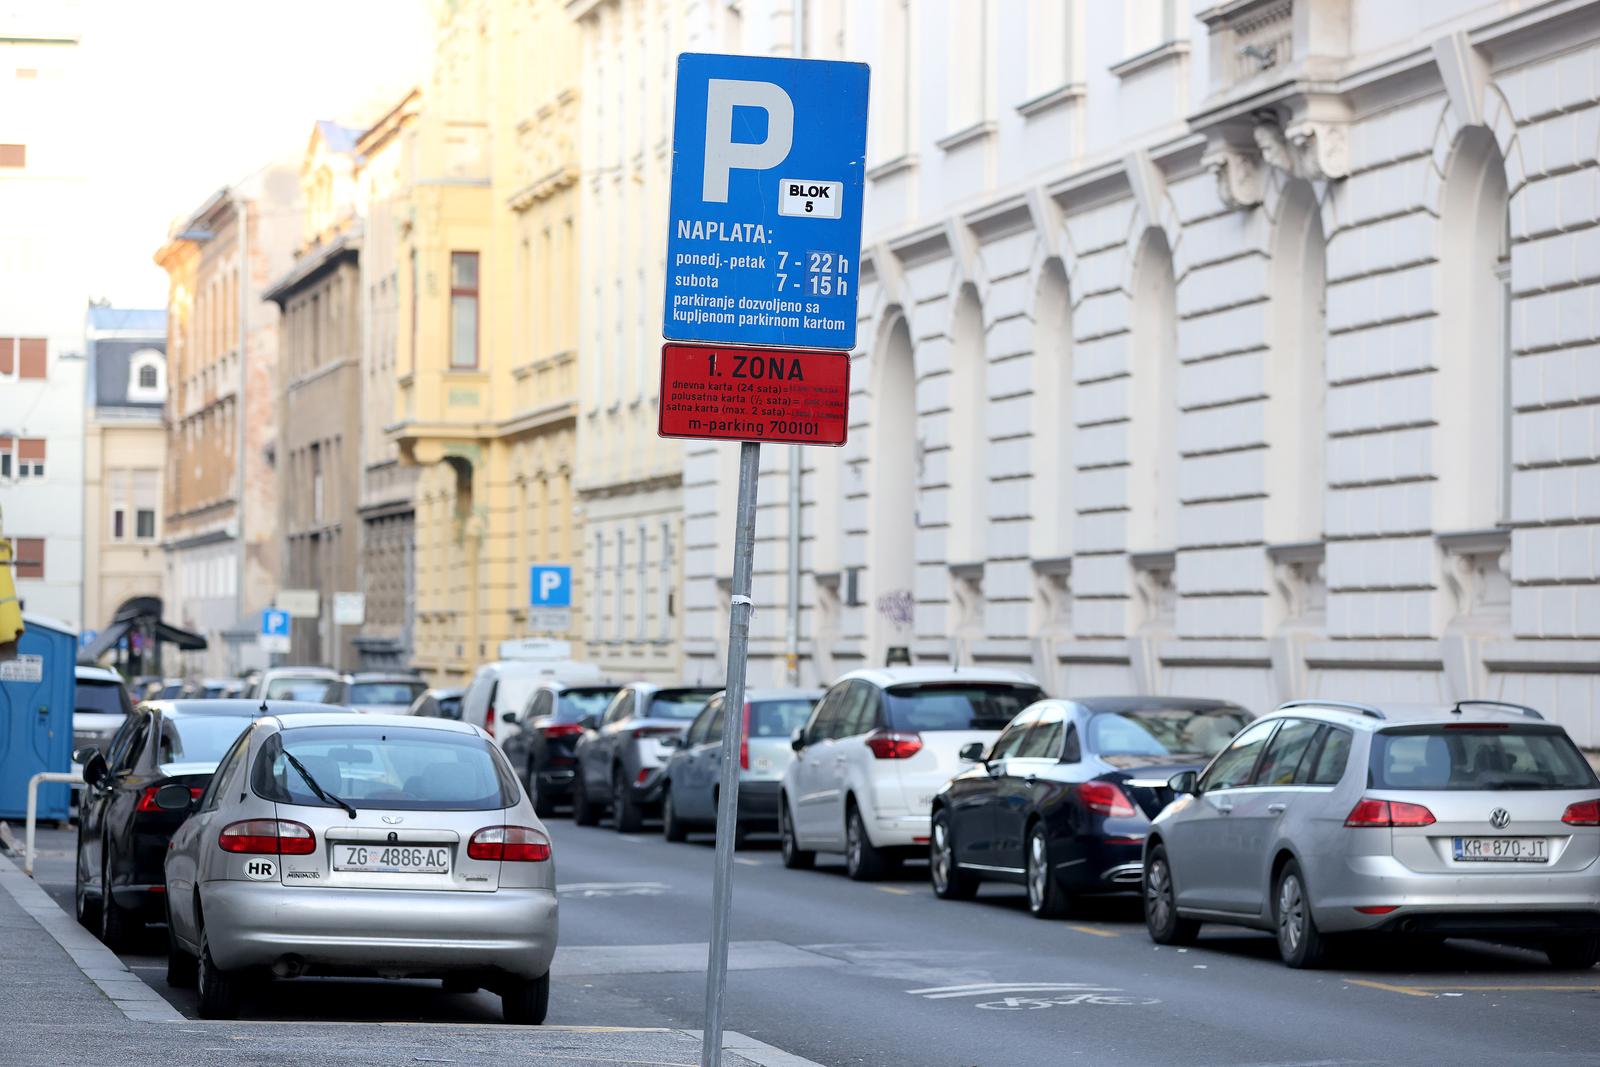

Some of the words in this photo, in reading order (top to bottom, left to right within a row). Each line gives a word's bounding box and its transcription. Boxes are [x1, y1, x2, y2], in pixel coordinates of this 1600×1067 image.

[702, 78, 794, 203] P
[789, 185, 830, 198] BLOK
[804, 201, 813, 212] 5
[677, 219, 773, 245] NAPLATA:
[777, 251, 789, 270] 7
[810, 253, 833, 273] 22
[838, 254, 849, 274] h
[675, 274, 719, 288] subota
[776, 273, 788, 292] 7
[810, 275, 832, 295] 15
[837, 276, 848, 296] h
[673, 294, 735, 310] parkiranje
[738, 296, 802, 314] dozvoljeno
[805, 302, 820, 314] sa
[673, 308, 735, 324] kupljenom
[738, 313, 800, 327] parkirnom
[803, 315, 846, 330] kartom
[708, 354, 722, 377] 1.
[732, 355, 804, 381] ZONA
[672, 380, 705, 390] dnevna
[708, 382, 733, 391] karta
[737, 383, 754, 393] (24
[721, 393, 746, 403] karta
[666, 403, 693, 412] satna
[695, 403, 719, 413] karta
[751, 406, 758, 415] 2
[688, 419, 764, 436] m-parking
[769, 420, 819, 436] 700101
[540, 571, 561, 601] P
[268, 614, 284, 633] P
[346, 847, 368, 865] ZG
[1464, 840, 1482, 857] KR
[1493, 840, 1545, 857] 870-JT
[248, 862, 273, 876] HR
